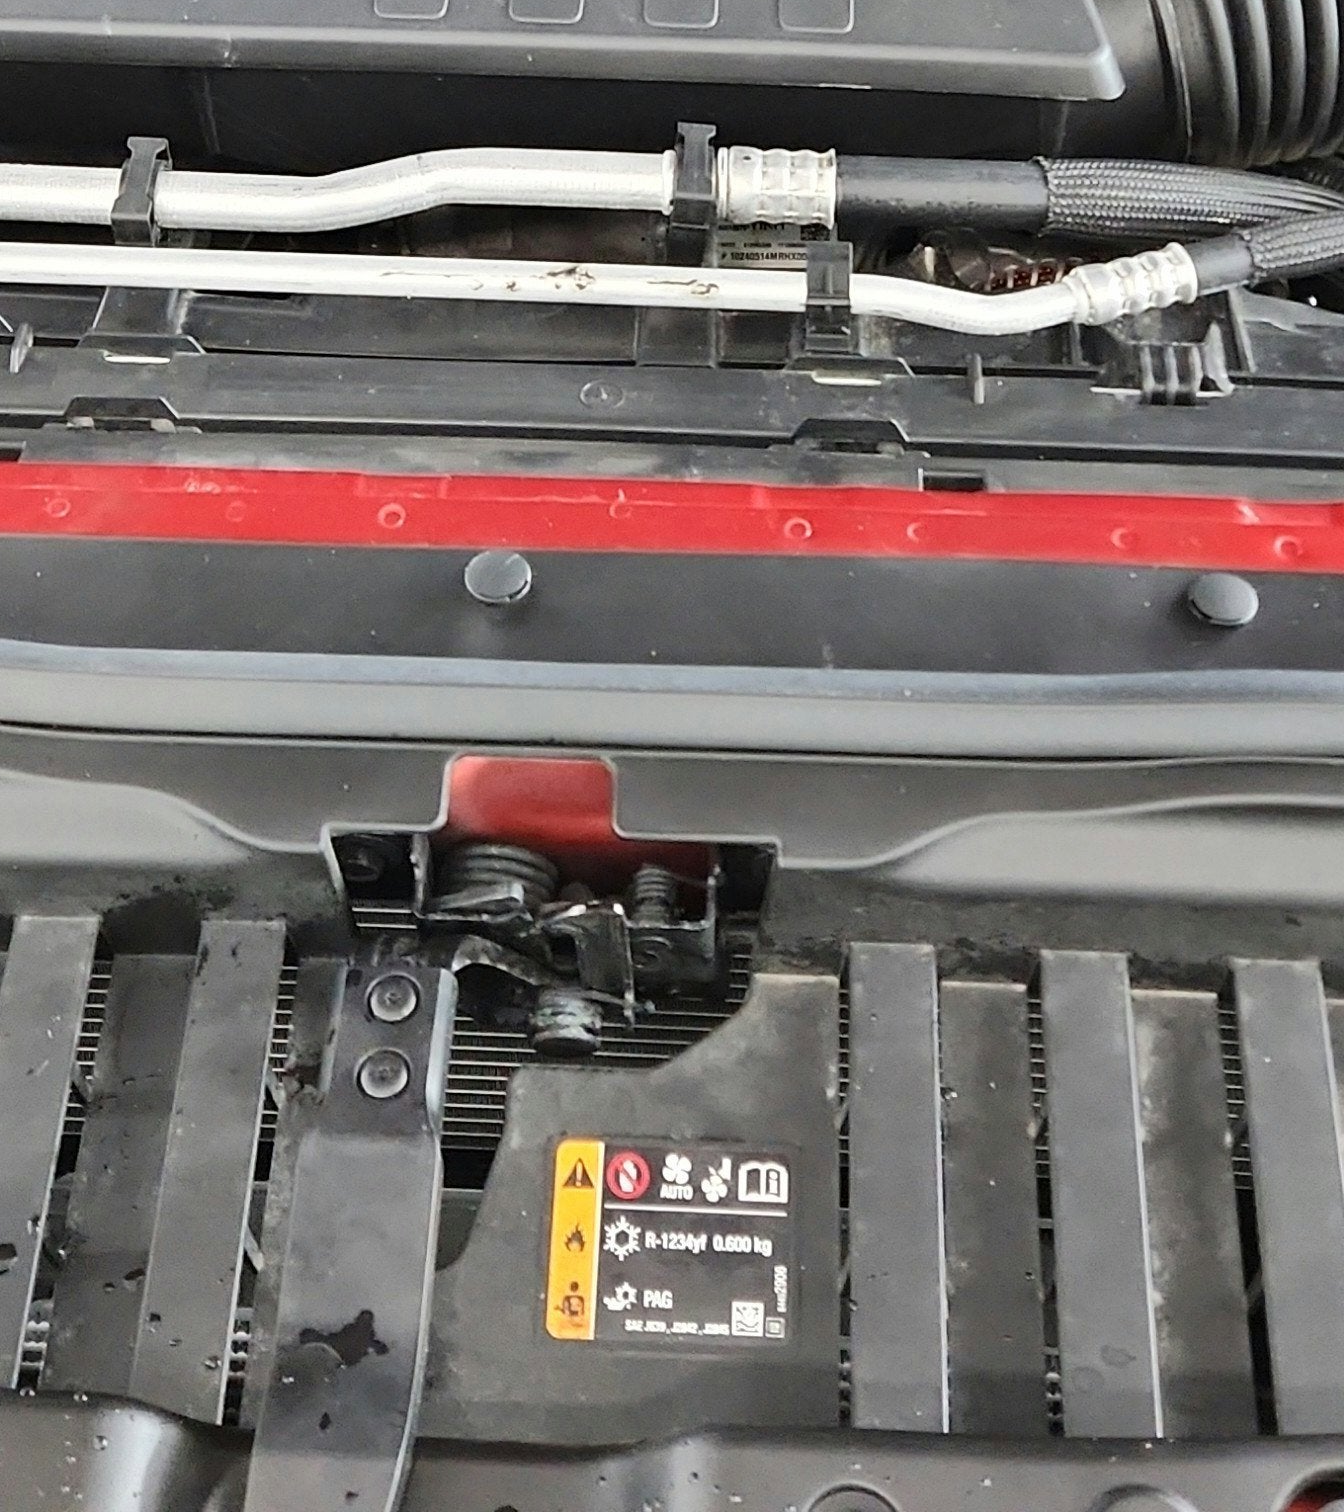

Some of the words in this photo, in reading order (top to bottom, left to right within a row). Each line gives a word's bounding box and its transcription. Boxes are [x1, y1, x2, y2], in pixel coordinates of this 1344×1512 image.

[659, 1183, 694, 1201] AUTO
[644, 1230, 707, 1253] R-1234yf
[712, 1234, 752, 1254] 0.600
[754, 1235, 773, 1257] kg
[643, 1290, 674, 1310] PAG
